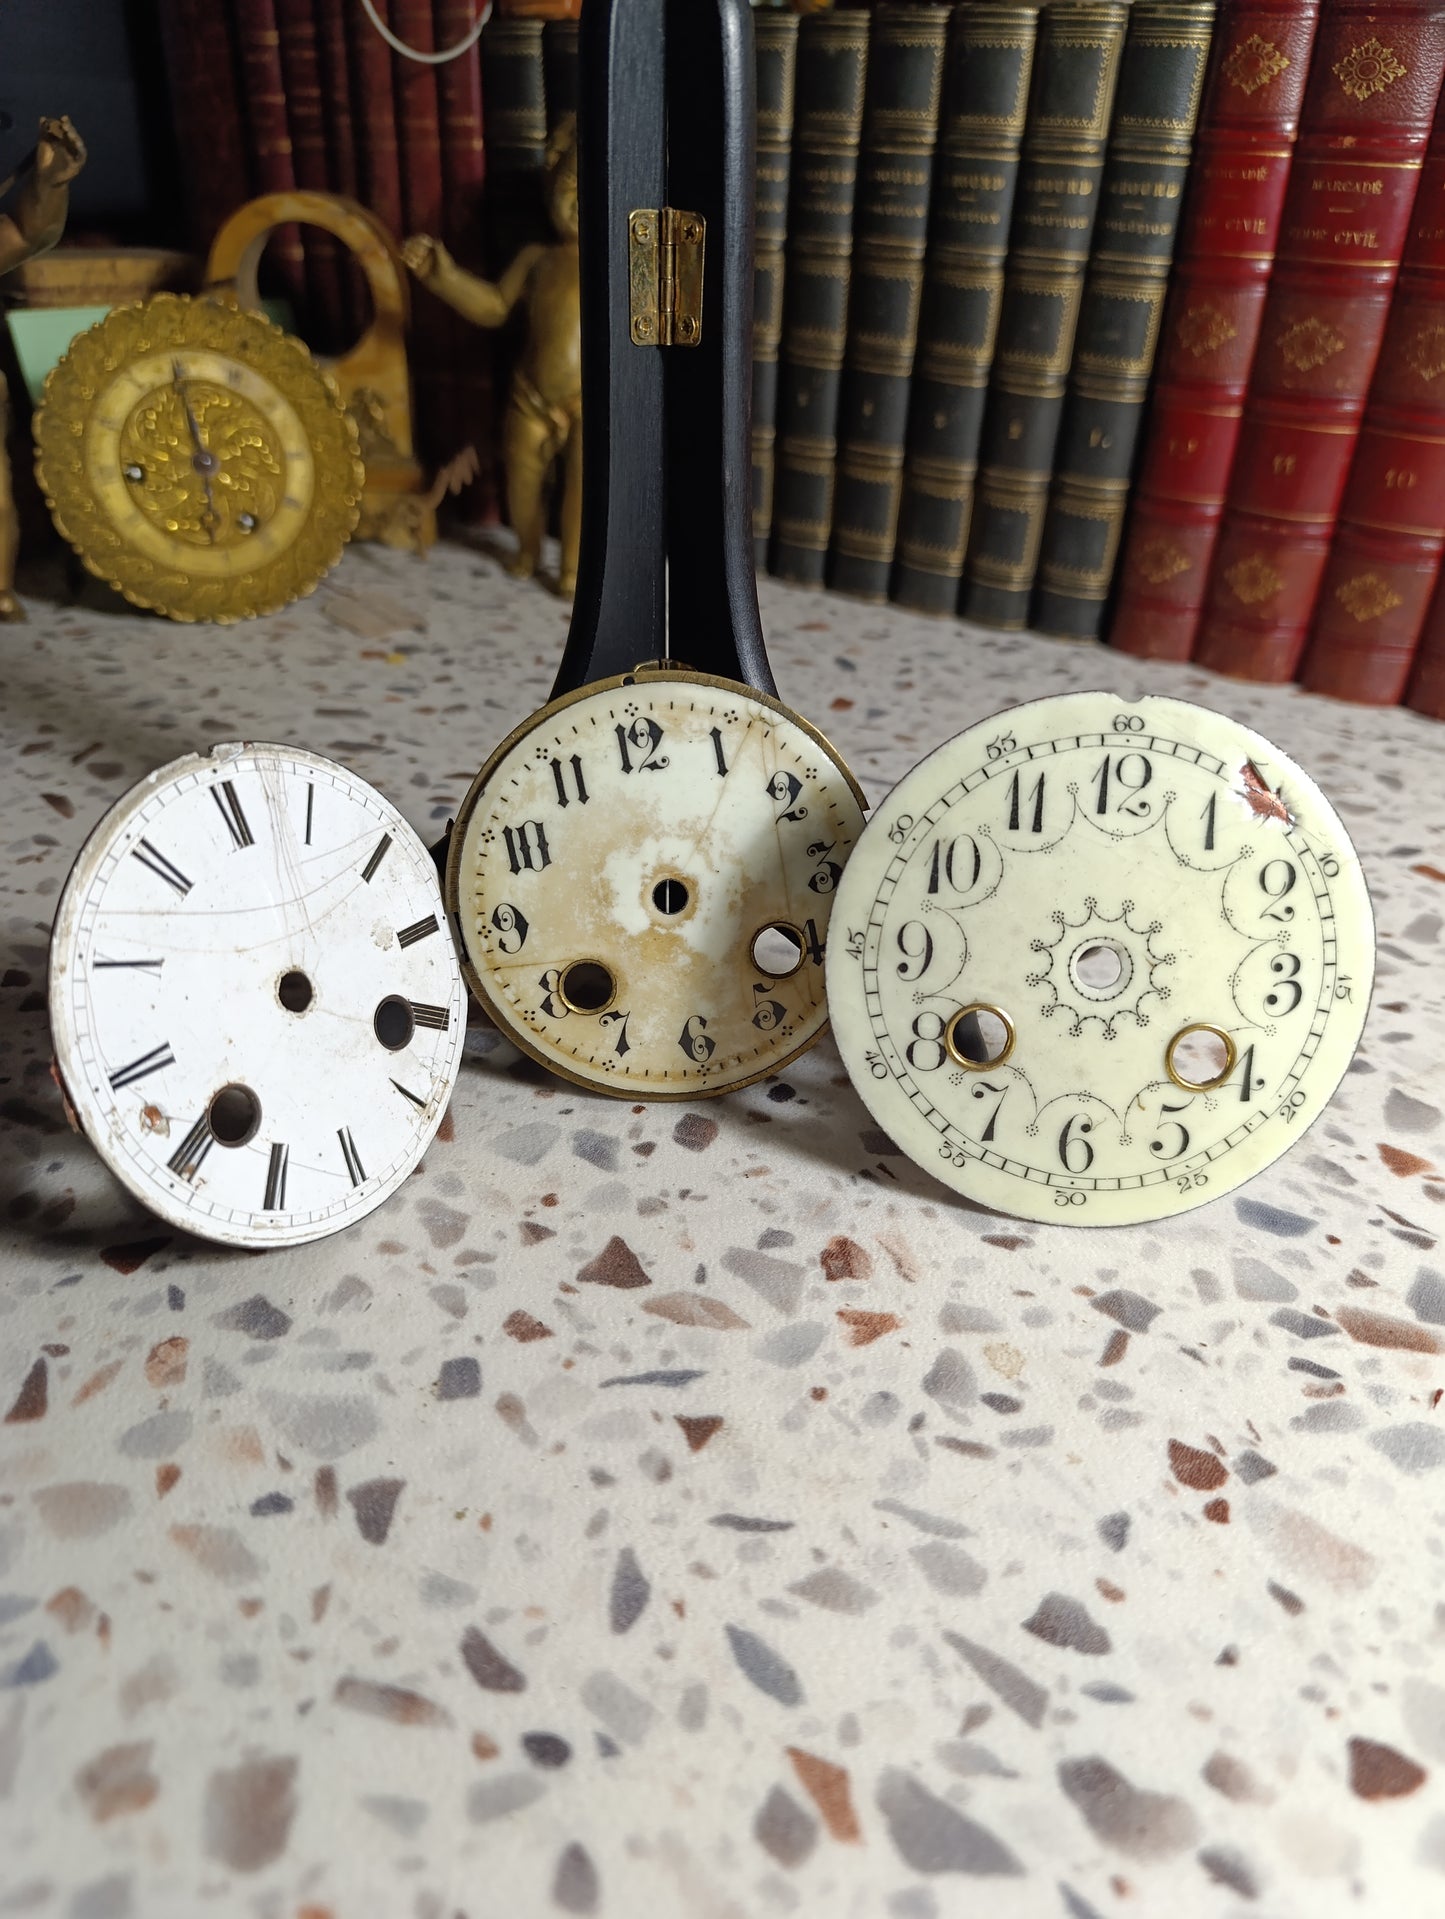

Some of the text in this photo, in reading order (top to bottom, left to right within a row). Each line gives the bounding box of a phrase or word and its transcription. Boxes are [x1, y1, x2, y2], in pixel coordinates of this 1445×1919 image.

[614, 716, 670, 775] 12
[986, 730, 1017, 760] 55
[1112, 714, 1145, 732] 60
[709, 726, 729, 778] 1
[549, 754, 590, 808] 11
[766, 770, 808, 825] 2
[1005, 768, 1045, 833] 11
[1091, 753, 1152, 818] 12
[888, 814, 914, 845] 50
[1200, 790, 1216, 850] 1
[806, 841, 843, 894] 3
[924, 833, 981, 894] 10
[1318, 852, 1340, 878] 10
[1259, 859, 1296, 922] 2
[491, 903, 529, 954] 9
[802, 919, 827, 966] 4
[845, 928, 866, 960] 45
[896, 920, 933, 981] 9
[538, 969, 571, 1019] 8
[752, 980, 787, 1031] 5
[1263, 953, 1302, 1017] 3
[1335, 974, 1353, 1004] 15
[599, 1010, 631, 1057] 7
[678, 1015, 716, 1062] 6
[906, 1011, 948, 1071] 8
[865, 1050, 888, 1079] 40
[1228, 1043, 1265, 1102] 4
[971, 1081, 1009, 1142] 7
[1149, 1096, 1196, 1160] 5
[1279, 1091, 1306, 1124] 20
[938, 1140, 971, 1168] 35
[1058, 1113, 1094, 1174] 6
[1054, 1190, 1087, 1207] 30
[1176, 1169, 1208, 1194] 25
